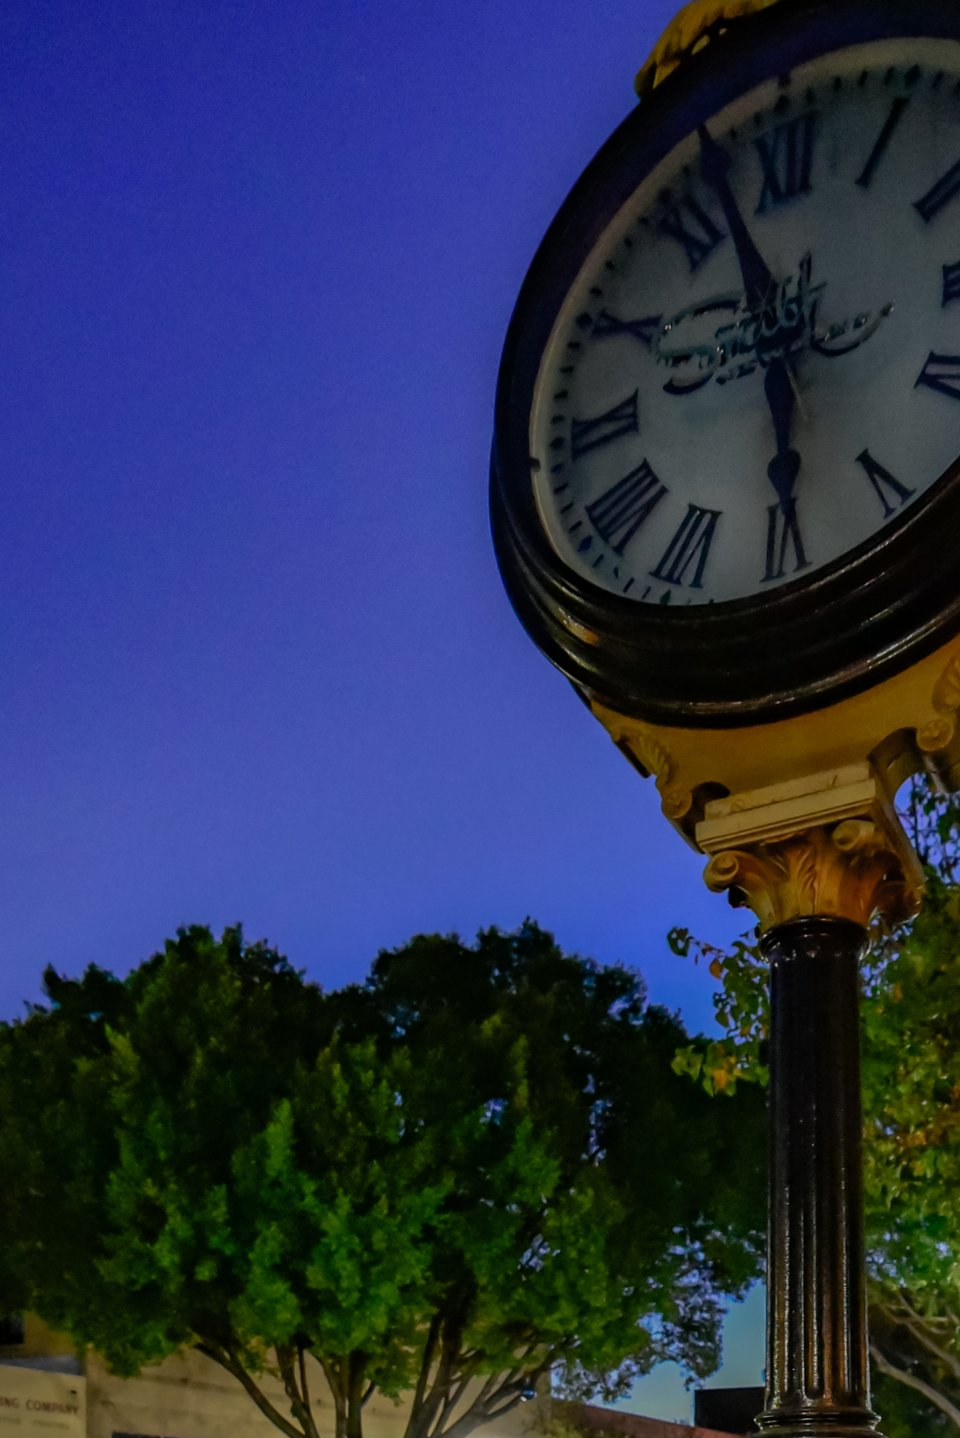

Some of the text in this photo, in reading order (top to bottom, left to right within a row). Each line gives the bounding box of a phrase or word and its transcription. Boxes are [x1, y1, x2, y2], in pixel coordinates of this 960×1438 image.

[754, 110, 820, 217] XII
[654, 190, 727, 274] XI
[590, 309, 664, 349] X
[571, 387, 639, 462] IX
[584, 457, 669, 557] VIII
[855, 448, 917, 520] V
[649, 503, 723, 589] VII
[760, 497, 813, 583] VI
[25, 1398, 80, 1415] COMPANY
